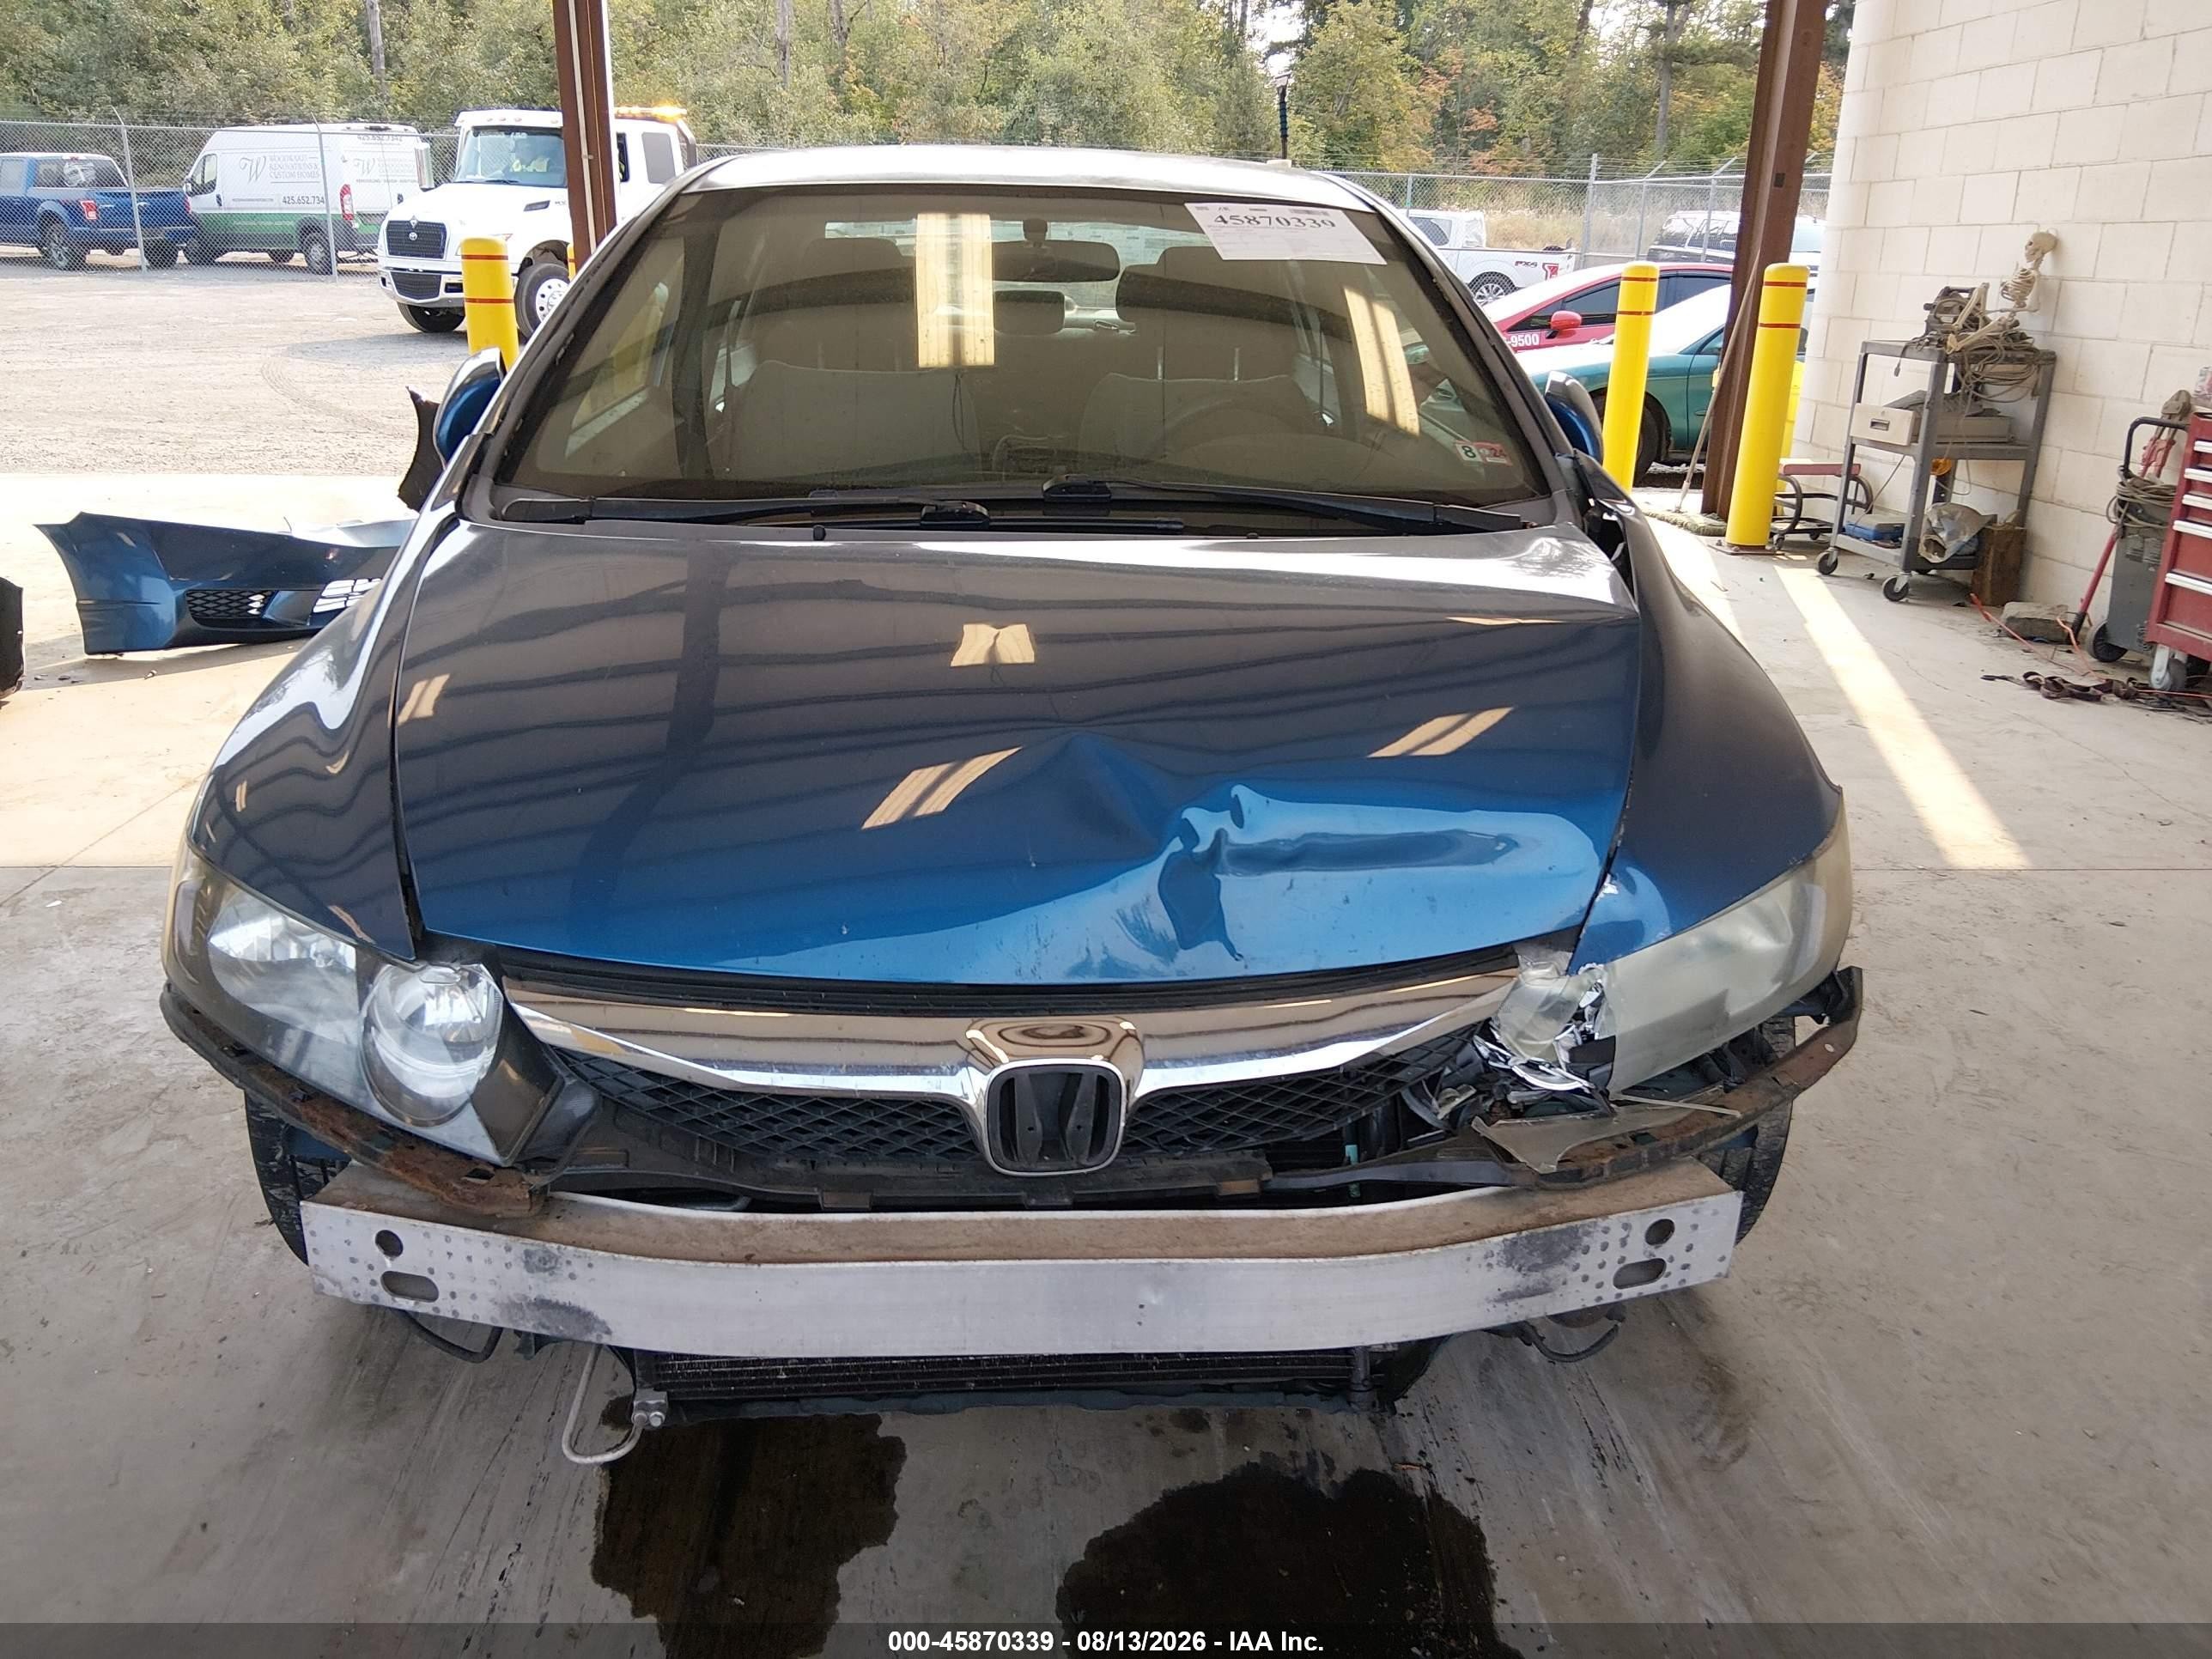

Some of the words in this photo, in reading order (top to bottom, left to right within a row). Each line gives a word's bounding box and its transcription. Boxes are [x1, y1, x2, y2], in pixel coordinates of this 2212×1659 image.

[282, 196, 325, 204] 425.652.734
[1214, 215, 1336, 228] 45870339
[1505, 334, 1539, 347] -9500
[1462, 446, 1476, 458] 8
